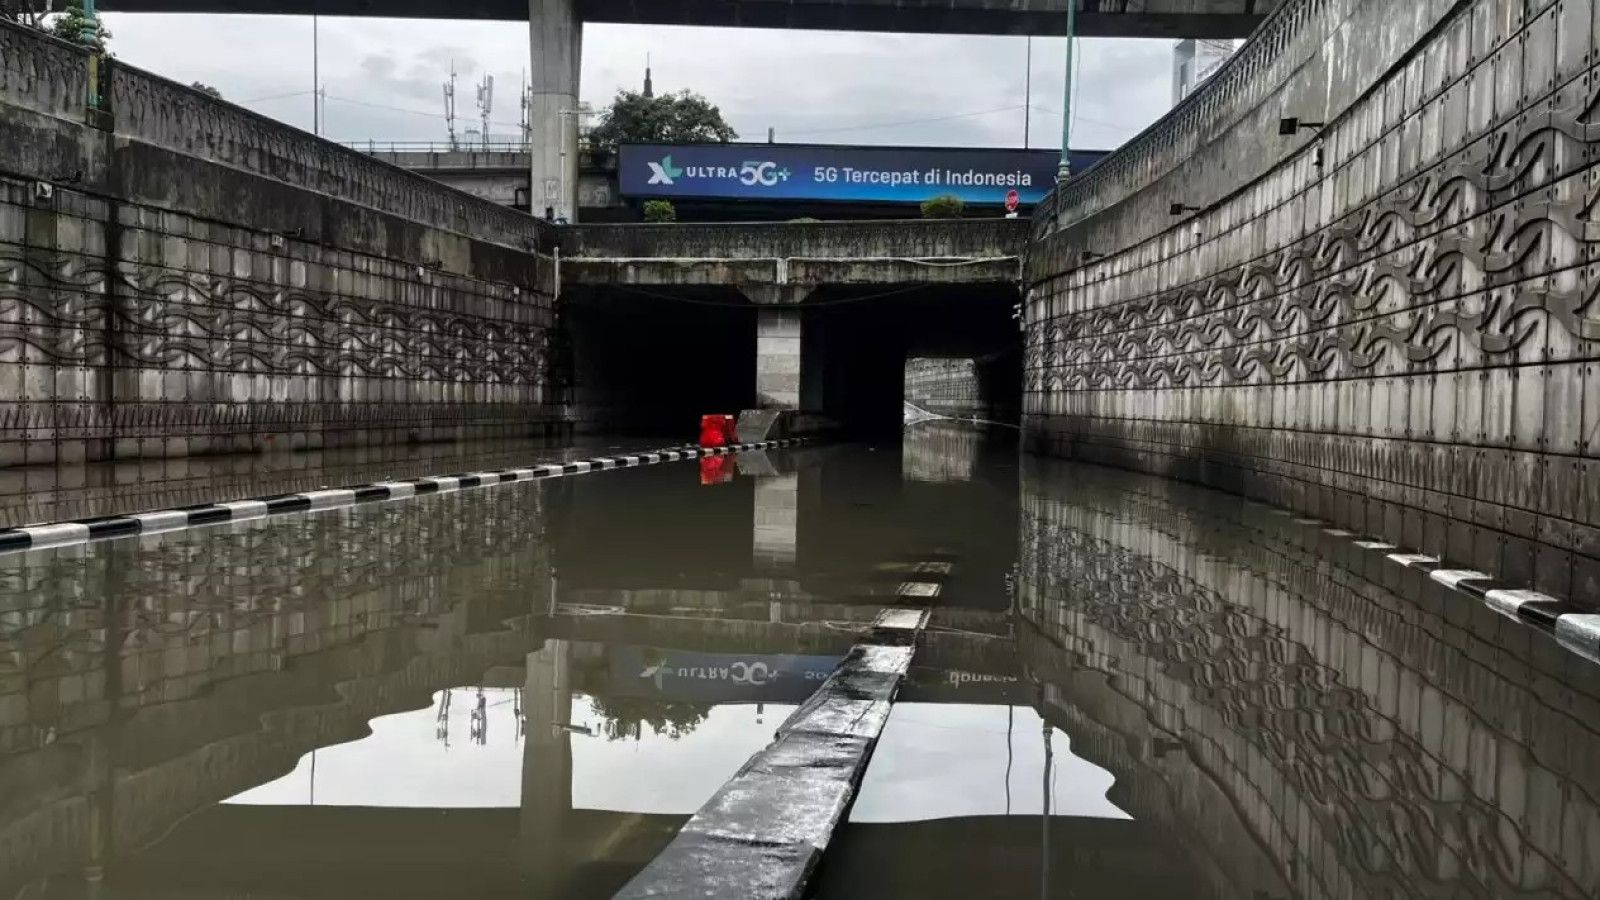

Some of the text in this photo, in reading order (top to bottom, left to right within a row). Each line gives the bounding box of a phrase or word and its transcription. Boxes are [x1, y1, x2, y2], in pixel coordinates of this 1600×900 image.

[686, 166, 738, 178] ULTRA
[814, 167, 1032, 187] 5G Tercepat di Indonesia
